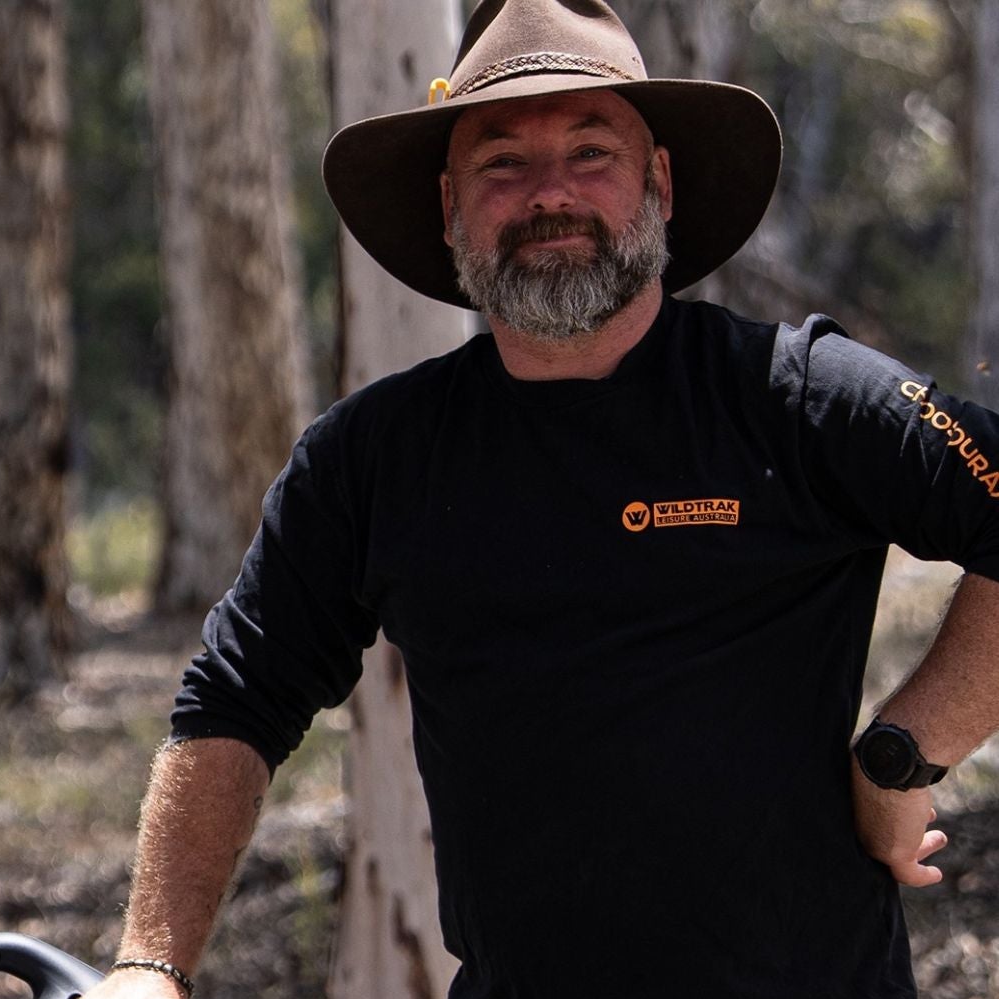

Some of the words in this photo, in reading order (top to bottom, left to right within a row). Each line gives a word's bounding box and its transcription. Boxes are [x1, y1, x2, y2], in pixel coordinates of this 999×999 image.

[656, 501, 736, 514] WILDTRAK
[657, 515, 690, 524] LEISURE
[693, 512, 737, 521] AUSTRALIA
